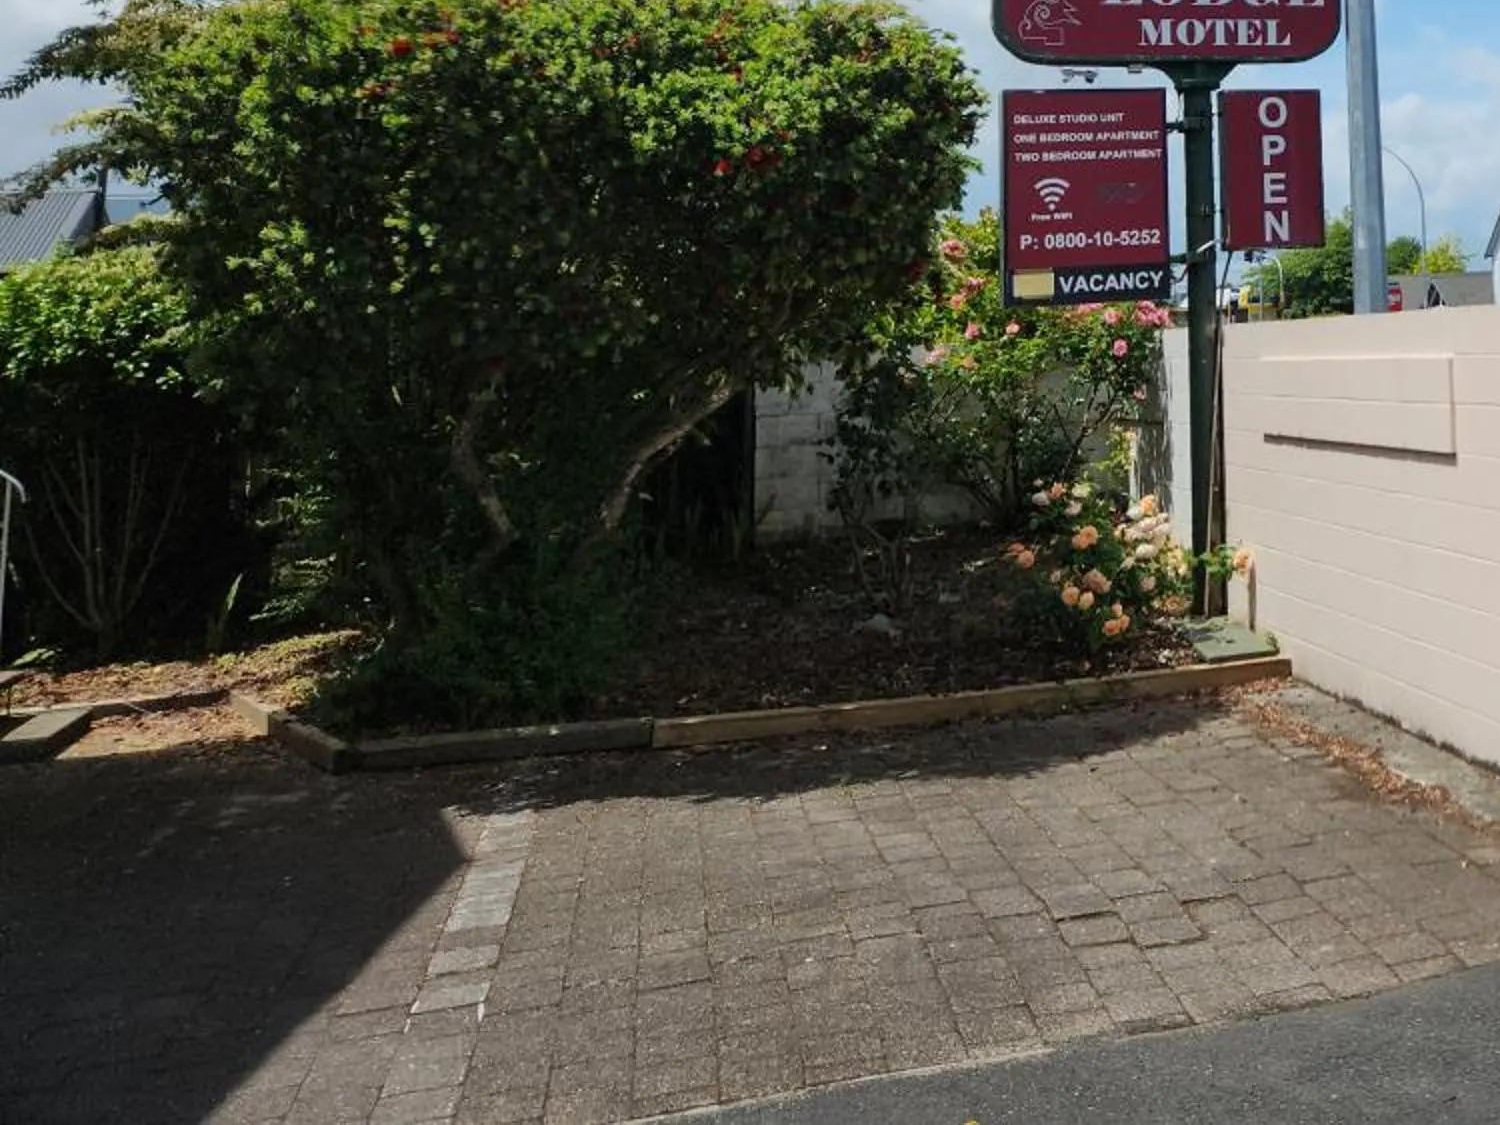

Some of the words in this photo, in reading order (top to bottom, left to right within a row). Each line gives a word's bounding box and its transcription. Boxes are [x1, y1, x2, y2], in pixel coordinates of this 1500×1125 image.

[1137, 18, 1292, 46] MOTEL
[1013, 114, 1057, 124] DELUXE
[1058, 113, 1098, 123] STUDIO
[1099, 112, 1125, 122] UNIT
[1013, 133, 1037, 144] ONE
[1039, 132, 1094, 142] BEDROOM
[1095, 130, 1160, 141] APARTMENT
[1014, 151, 1040, 162] TWO
[1041, 151, 1097, 162] BEDROOM
[1099, 148, 1163, 160] APARTMENT
[1258, 96, 1290, 243] OPEN
[1020, 234, 1039, 250] P:
[1044, 228, 1161, 249] 0800-10-5252
[1058, 270, 1164, 293] VACANCY
